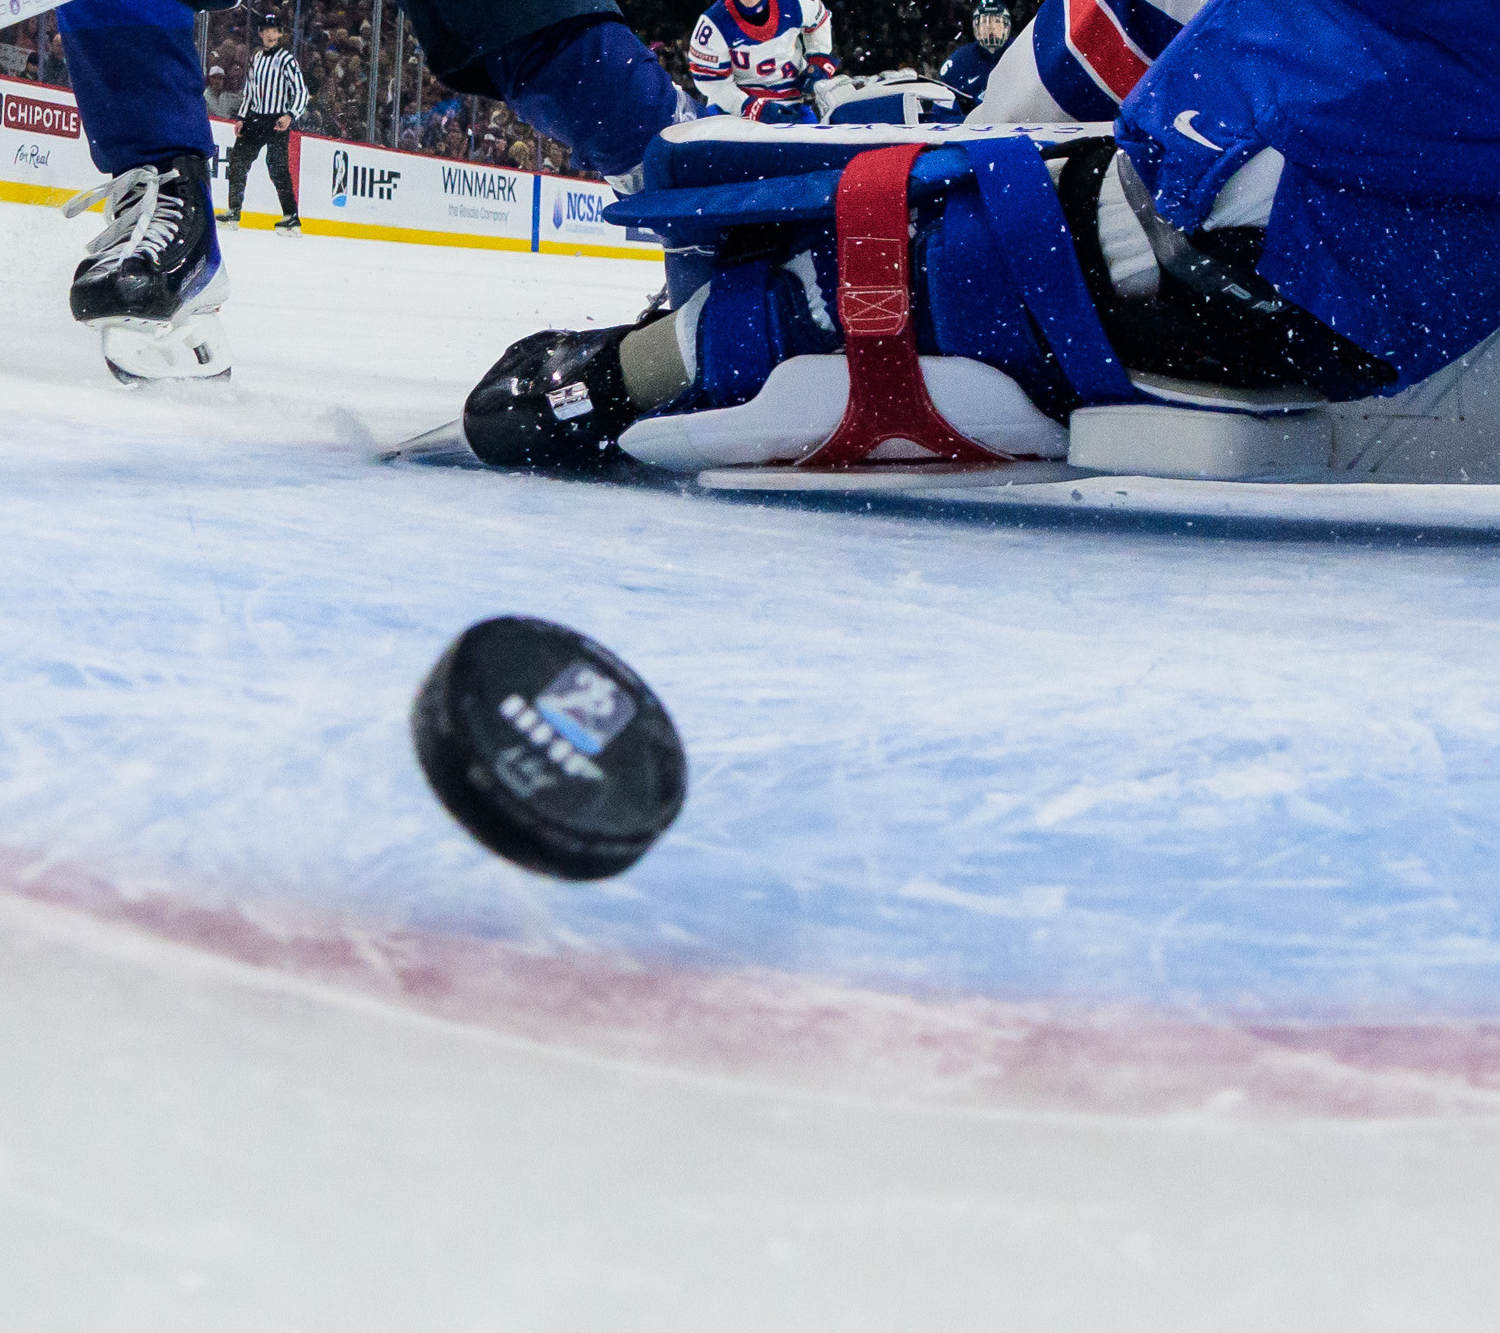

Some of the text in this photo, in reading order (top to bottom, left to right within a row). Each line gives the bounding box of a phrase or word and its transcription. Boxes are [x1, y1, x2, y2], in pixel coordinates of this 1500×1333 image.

[694, 20, 713, 46] 18
[7, 101, 79, 133] CHIPOTLE
[352, 165, 401, 201] IIHF
[441, 166, 519, 203] WINMARK
[566, 192, 604, 222] NCSA
